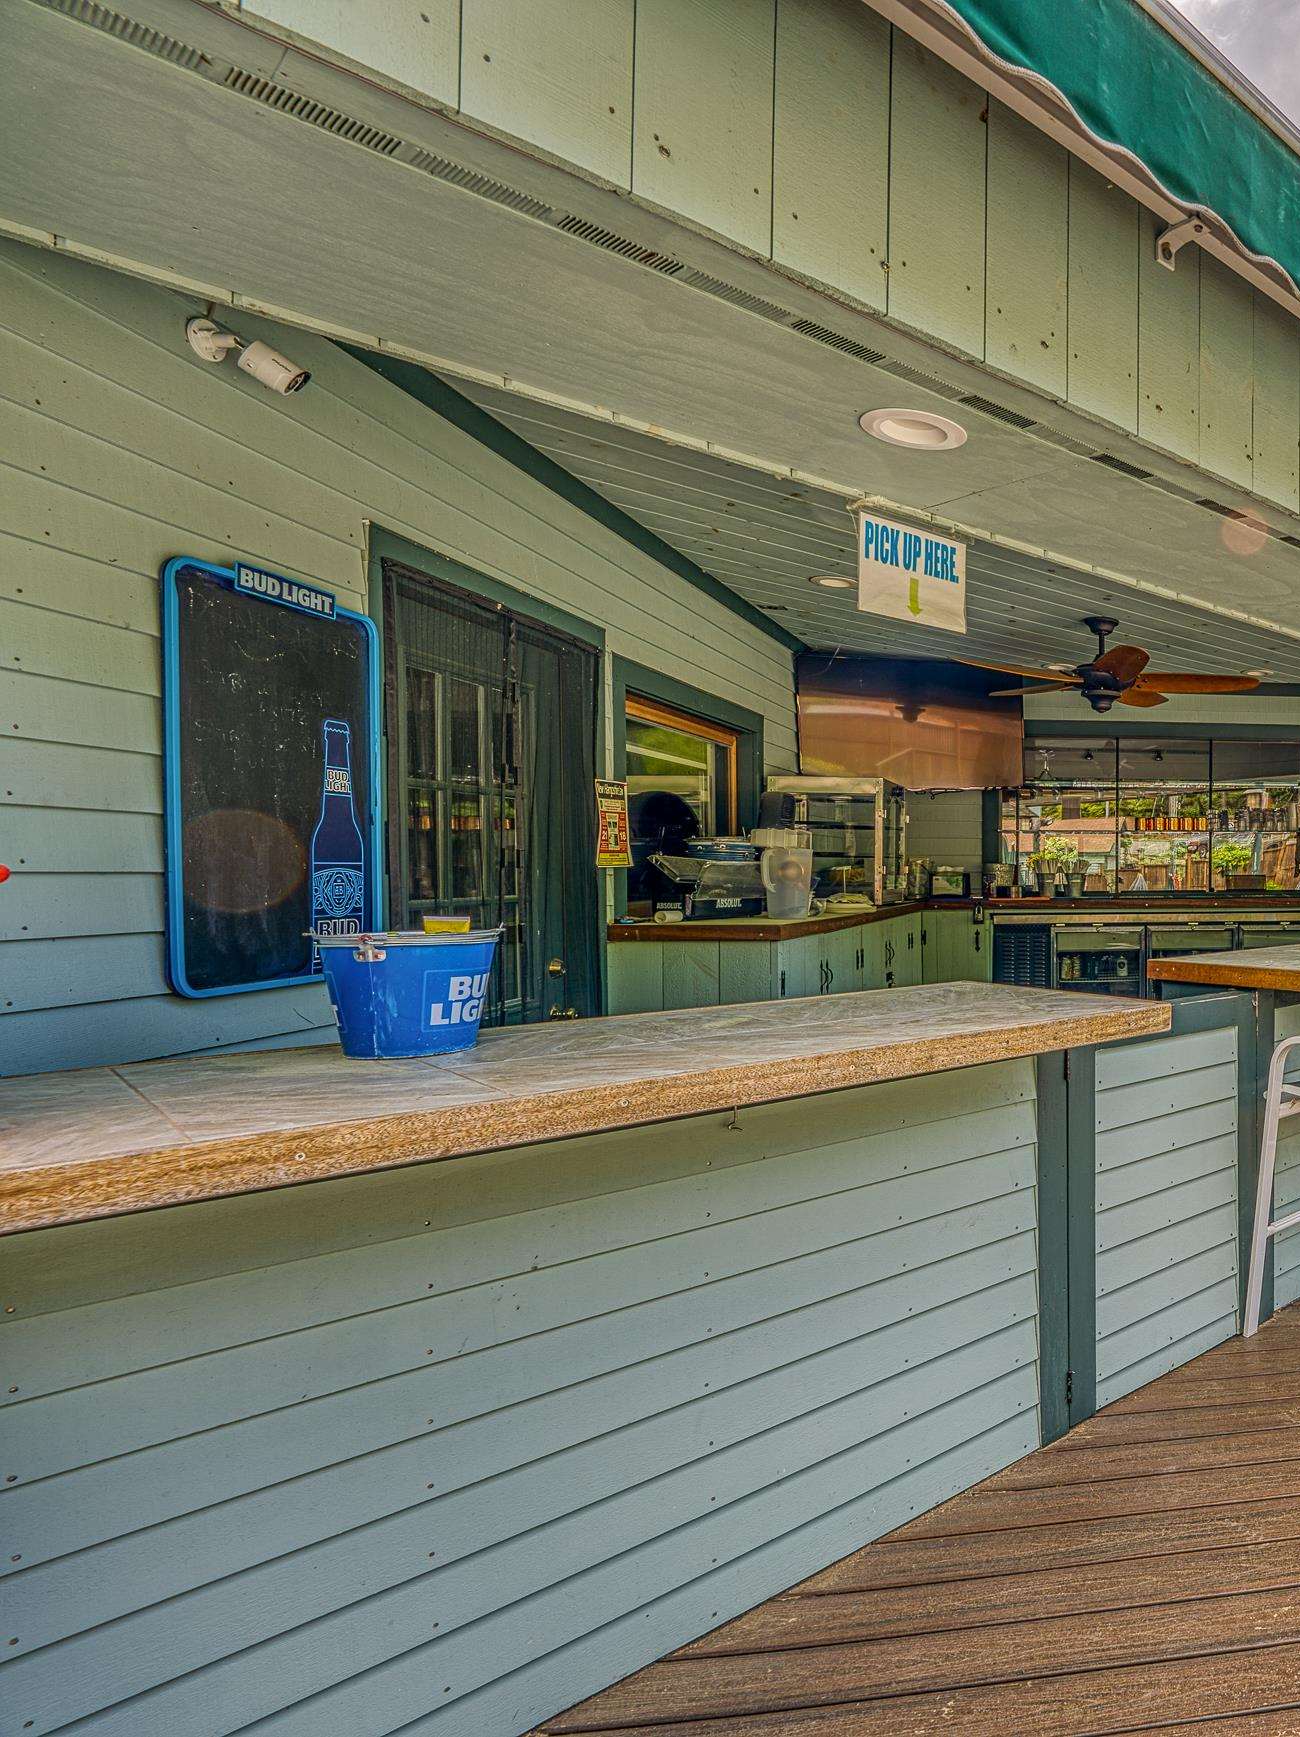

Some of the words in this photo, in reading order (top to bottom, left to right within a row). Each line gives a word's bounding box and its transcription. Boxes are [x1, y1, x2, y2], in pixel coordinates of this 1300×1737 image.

[864, 520, 899, 567] PICK
[902, 532, 921, 572] UP
[923, 538, 959, 584] HERE.
[240, 568, 280, 596] BUD
[327, 769, 348, 782] BUD
[317, 919, 360, 936] BUD
[430, 999, 484, 1026] LIG
